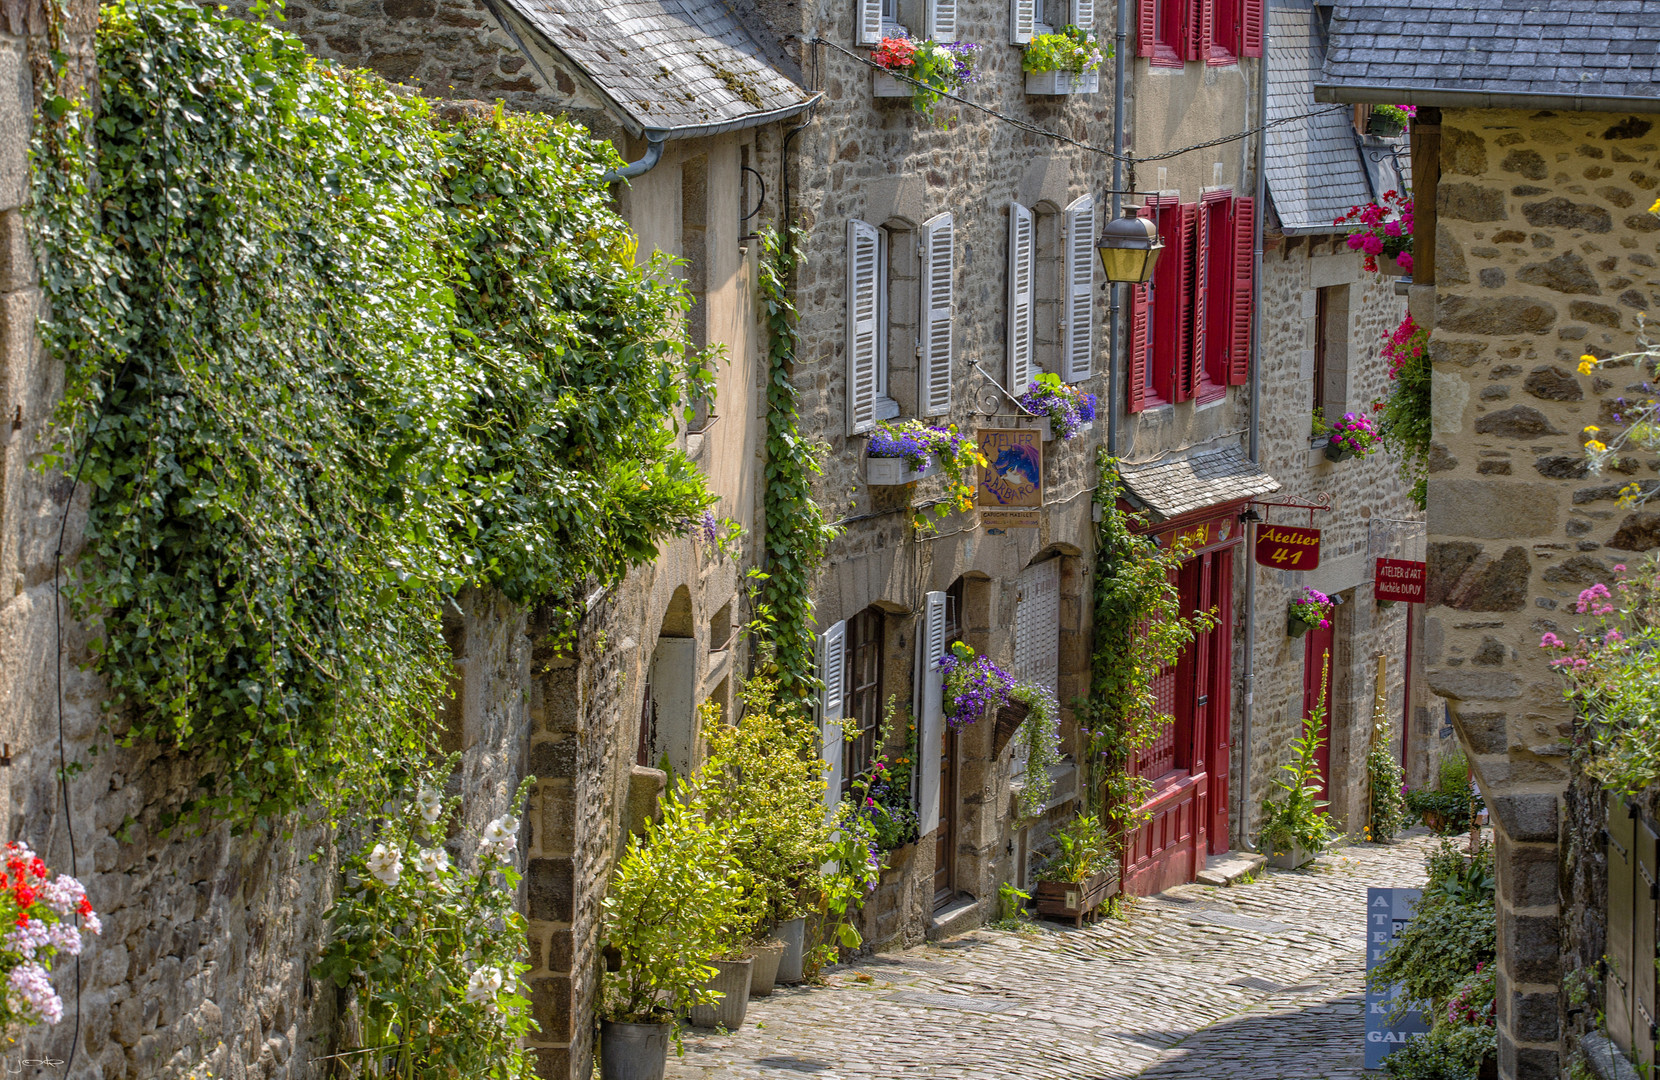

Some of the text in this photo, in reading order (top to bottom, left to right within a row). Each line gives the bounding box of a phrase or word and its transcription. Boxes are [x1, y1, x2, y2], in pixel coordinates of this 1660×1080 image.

[983, 432, 1033, 447] ATELIER
[984, 469, 1034, 501] BARBARO
[1257, 528, 1319, 546] Atelier
[1271, 548, 1303, 565] 41
[1380, 566, 1422, 579] ATELIER d'ART
[1401, 584, 1421, 596] DUPUY
[1370, 896, 1390, 1014] ATELR
